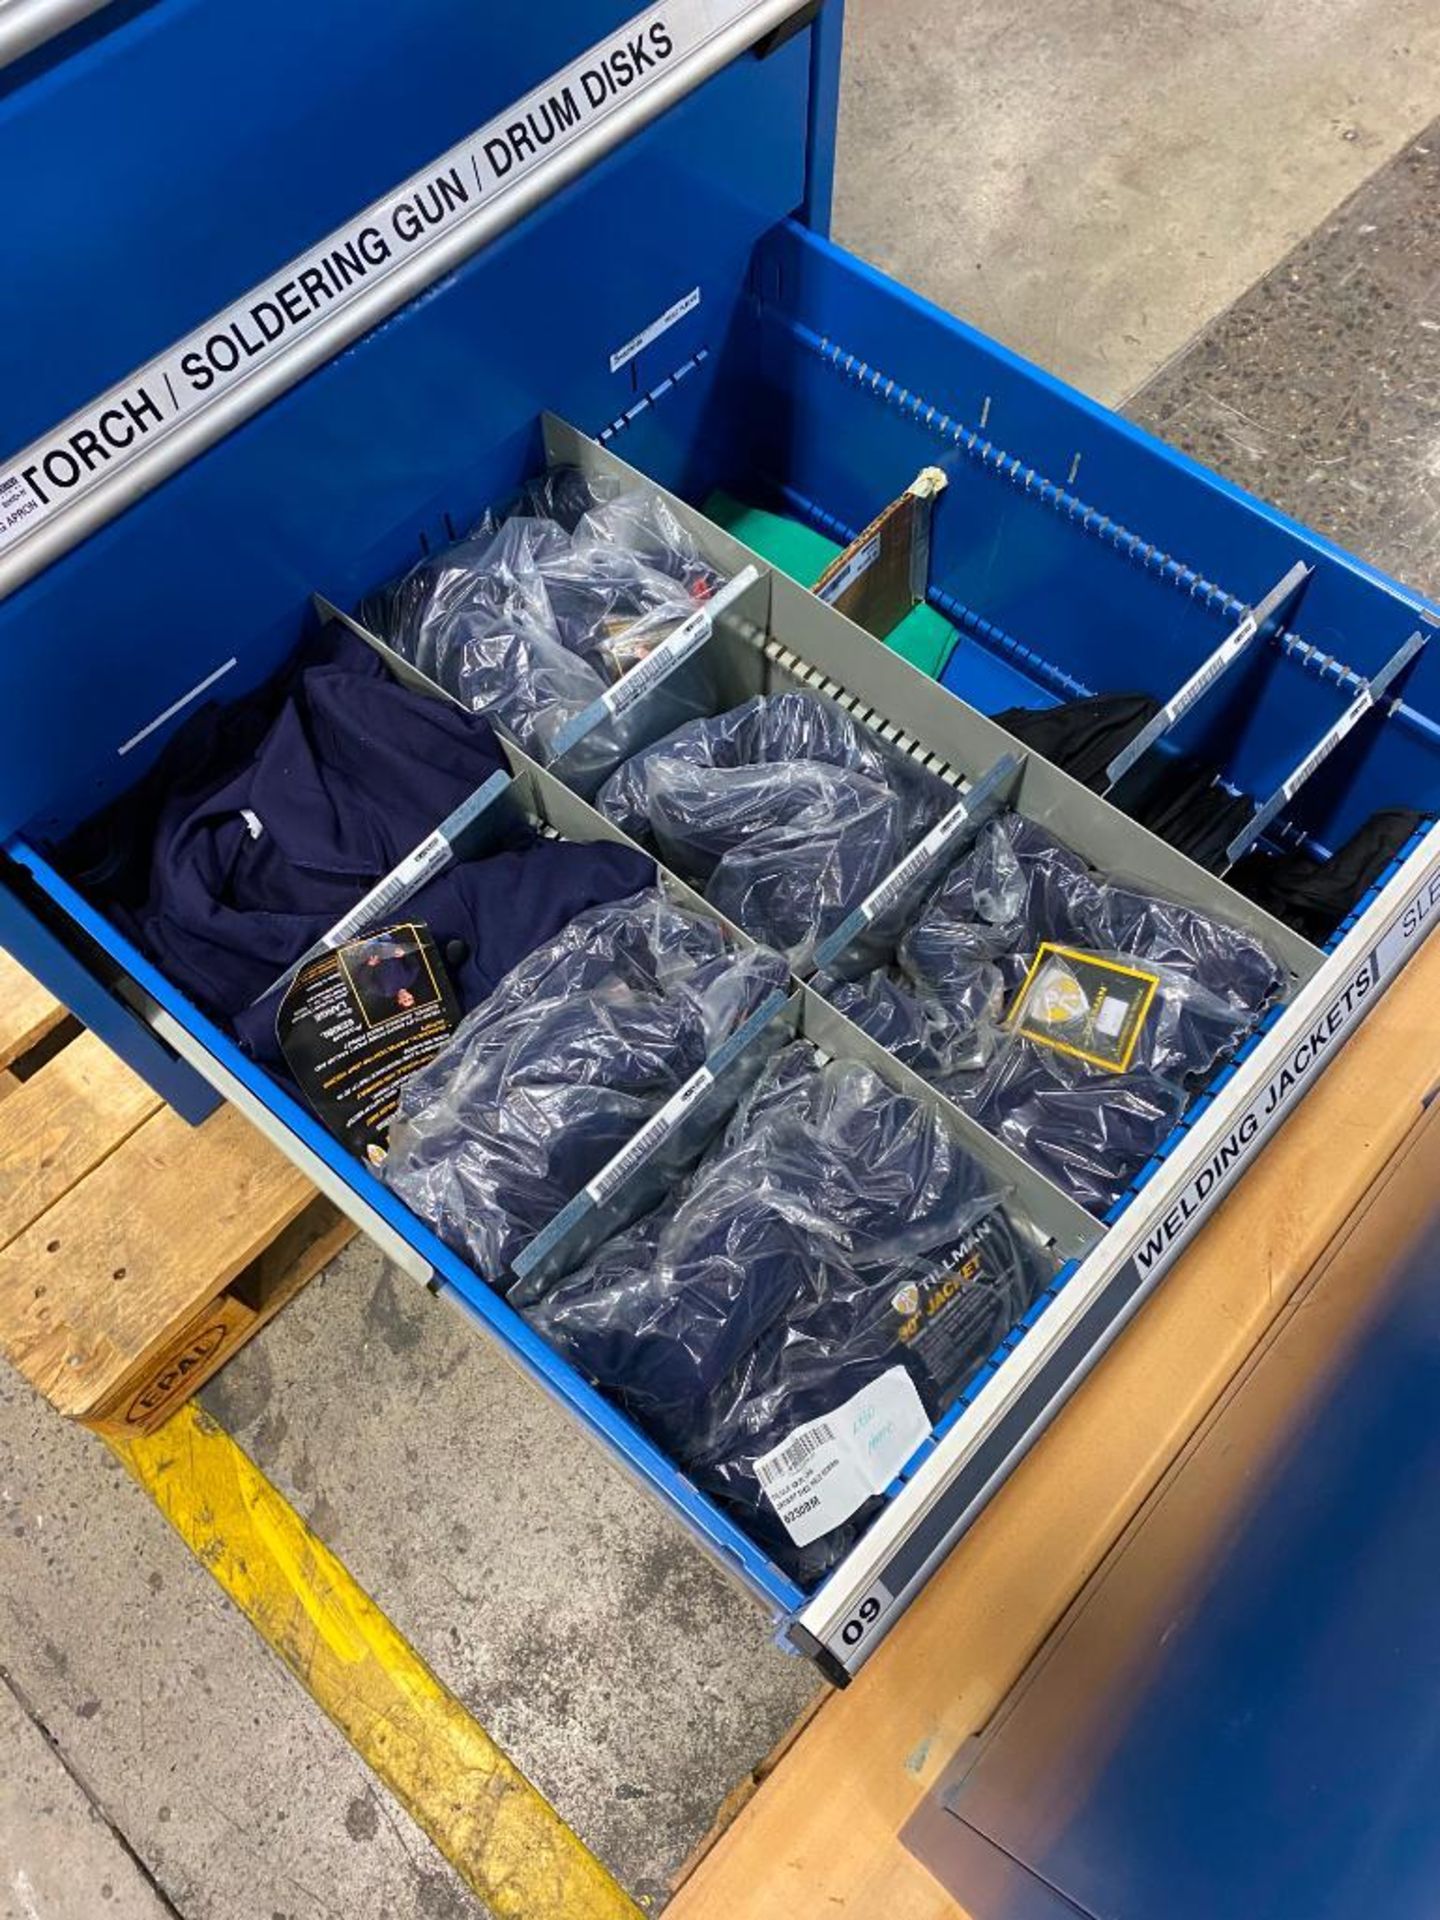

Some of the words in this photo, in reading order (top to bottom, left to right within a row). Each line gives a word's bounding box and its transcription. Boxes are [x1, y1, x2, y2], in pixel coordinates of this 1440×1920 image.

[22, 387, 165, 505] TORCH
[180, 227, 392, 391] SOLDERING
[392, 168, 469, 242] GUN
[482, 87, 582, 178] DRUM
[579, 22, 673, 109] DISKS
[6, 499, 39, 527] APRON
[1138, 1113, 1259, 1269] WELDING
[1265, 967, 1371, 1115] JACKETS
[917, 1220, 991, 1292] TILLMAN
[140, 1341, 213, 1408] EPAL
[842, 1597, 881, 1646] 09
